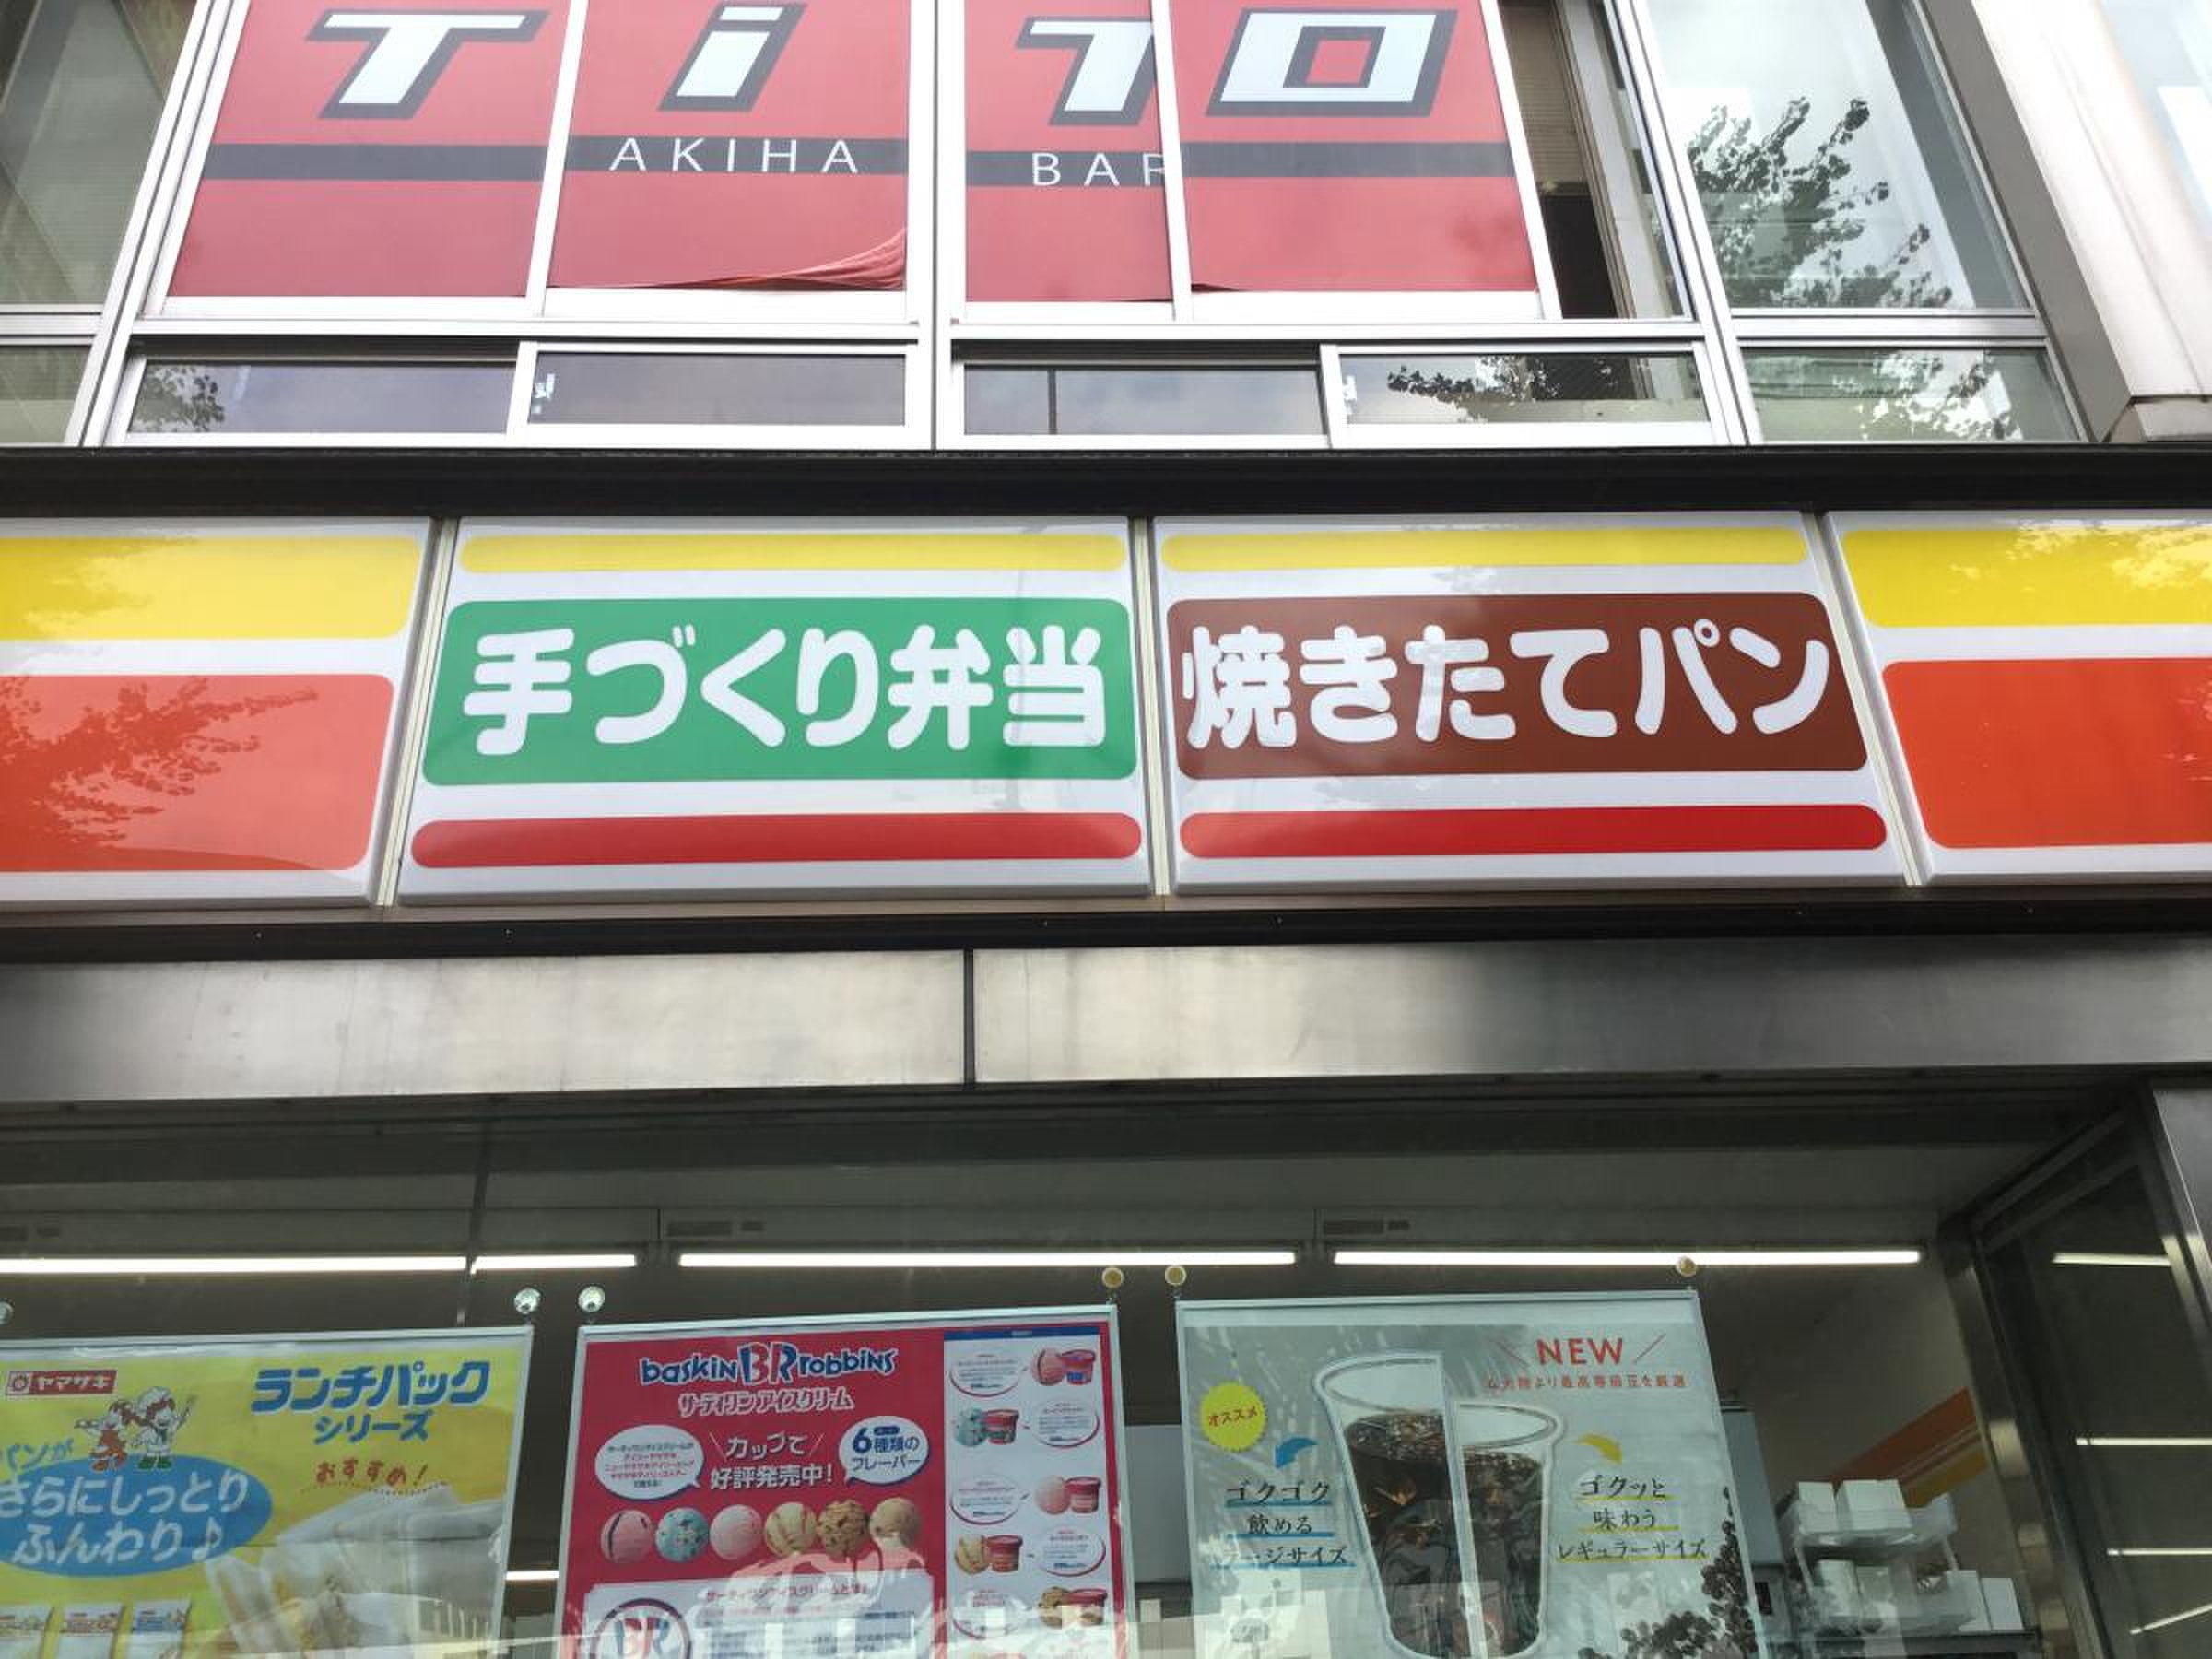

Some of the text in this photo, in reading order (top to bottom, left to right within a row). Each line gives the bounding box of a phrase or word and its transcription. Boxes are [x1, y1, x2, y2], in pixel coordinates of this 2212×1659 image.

[608, 137, 858, 173] AKIHA
[463, 624, 1106, 756] 手づくり弁当
[1182, 618, 1830, 750] 焼きたてパン
[1535, 1337, 1623, 1365] NEW
[37, 1374, 112, 1393] ヤマザキ
[250, 1360, 491, 1414] ランチパック
[313, 1410, 433, 1446] シリーズ
[1208, 1406, 1258, 1428] オススメ
[851, 1455, 922, 1471] フレーバー
[0, 1468, 249, 1519] さらにしっとり
[1226, 1479, 1330, 1505] ゴクゴク
[1580, 1475, 1667, 1499] ゴクッと
[1247, 1514, 1312, 1535] 飲める
[1593, 1507, 1656, 1532] 味わう
[1557, 1537, 1707, 1560] レギュラーサイズ
